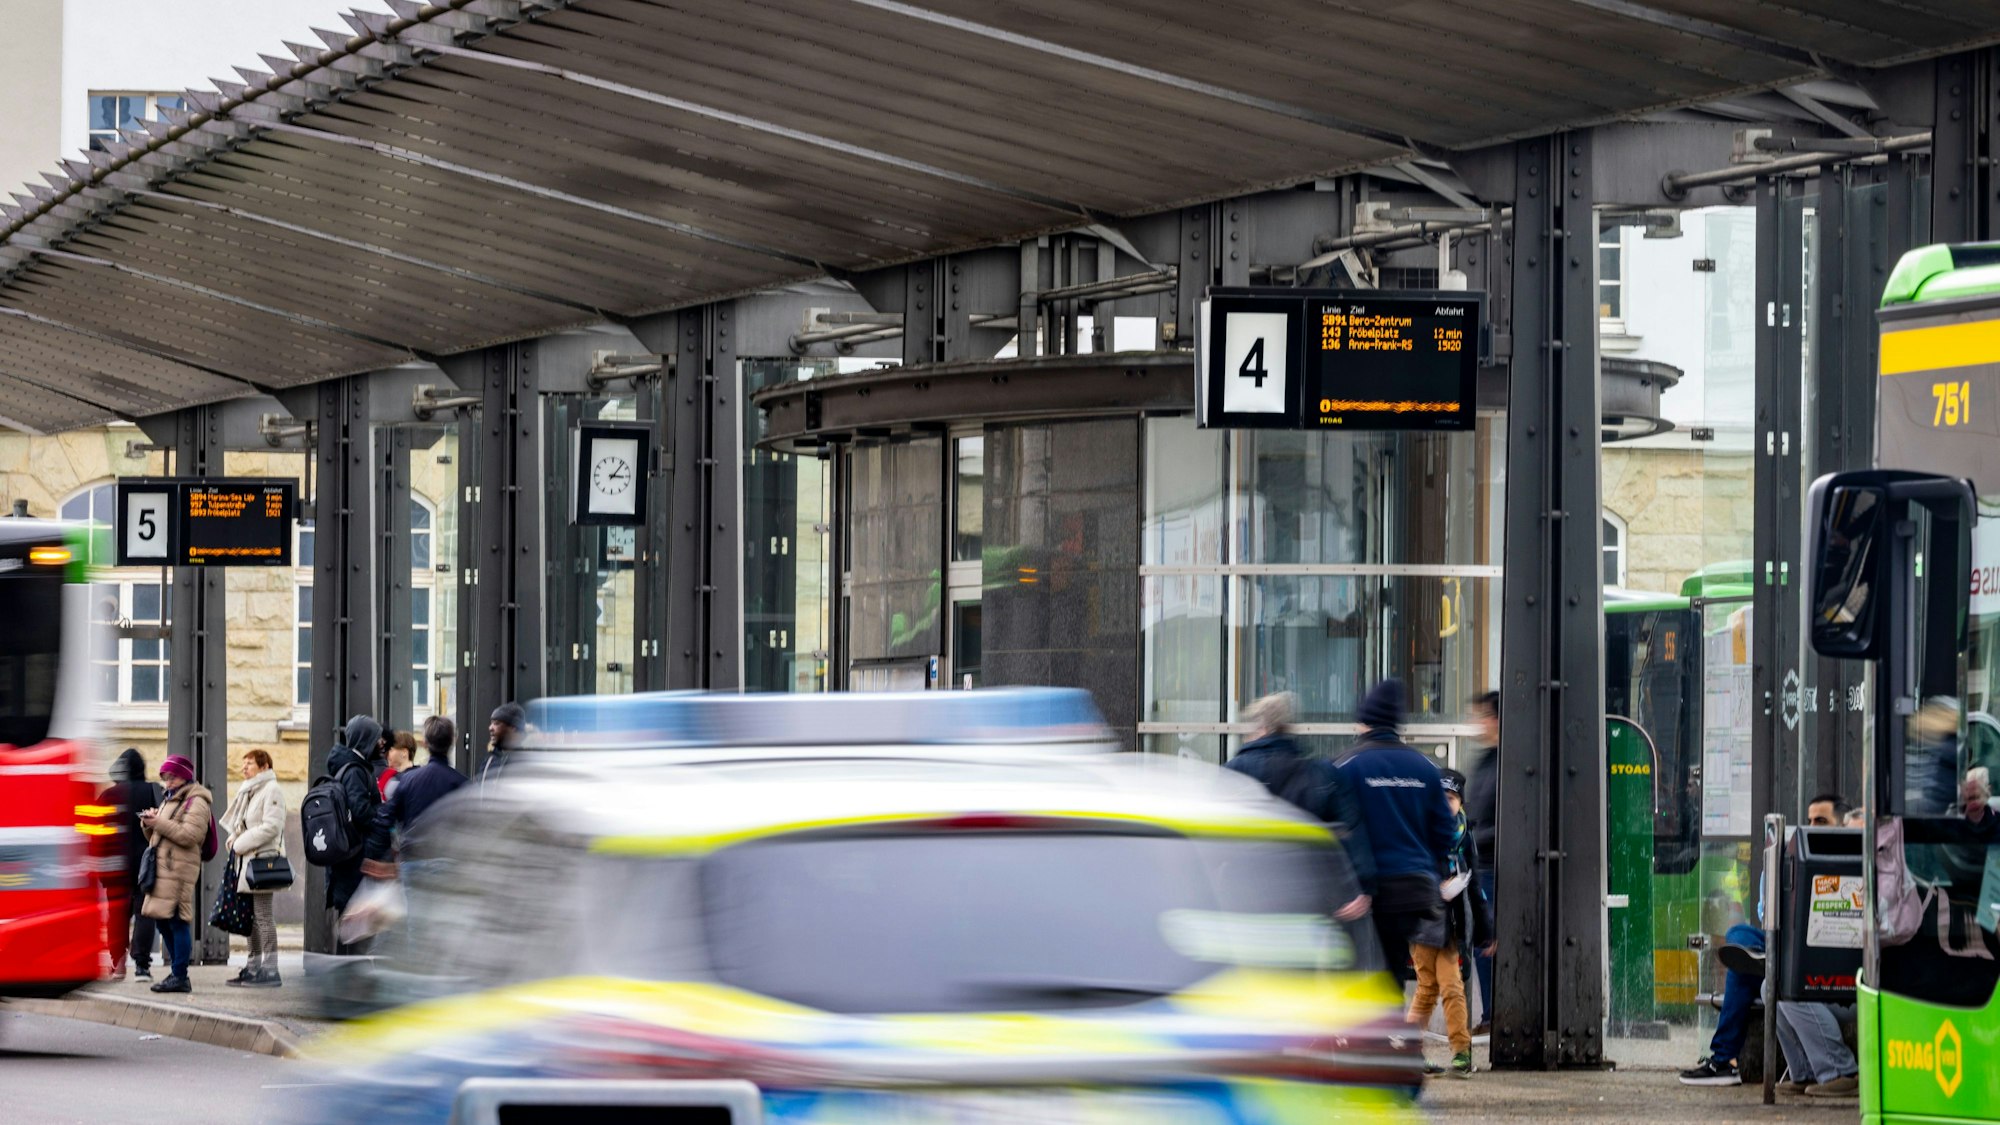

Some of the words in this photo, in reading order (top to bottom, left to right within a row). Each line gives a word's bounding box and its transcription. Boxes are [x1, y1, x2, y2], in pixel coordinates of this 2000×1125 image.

[1322, 305, 1342, 314] Linie
[1350, 305, 1365, 314] Ziel
[1435, 306, 1464, 316] Abfahrt
[1349, 315, 1412, 327] Bero-Zentrum
[1321, 327, 1341, 338] 143
[1349, 327, 1399, 340] Fröbelplatz
[1433, 328, 1444, 339] 12
[1446, 328, 1462, 339] min
[1321, 339, 1341, 350] 136
[1348, 339, 1413, 351] Anne-Frank-RS
[1239, 337, 1268, 388] 4
[1932, 381, 1970, 427] 751
[138, 508, 156, 541] 5
[1611, 764, 1650, 775] STOAG
[1888, 1040, 1934, 1071] STOAG
